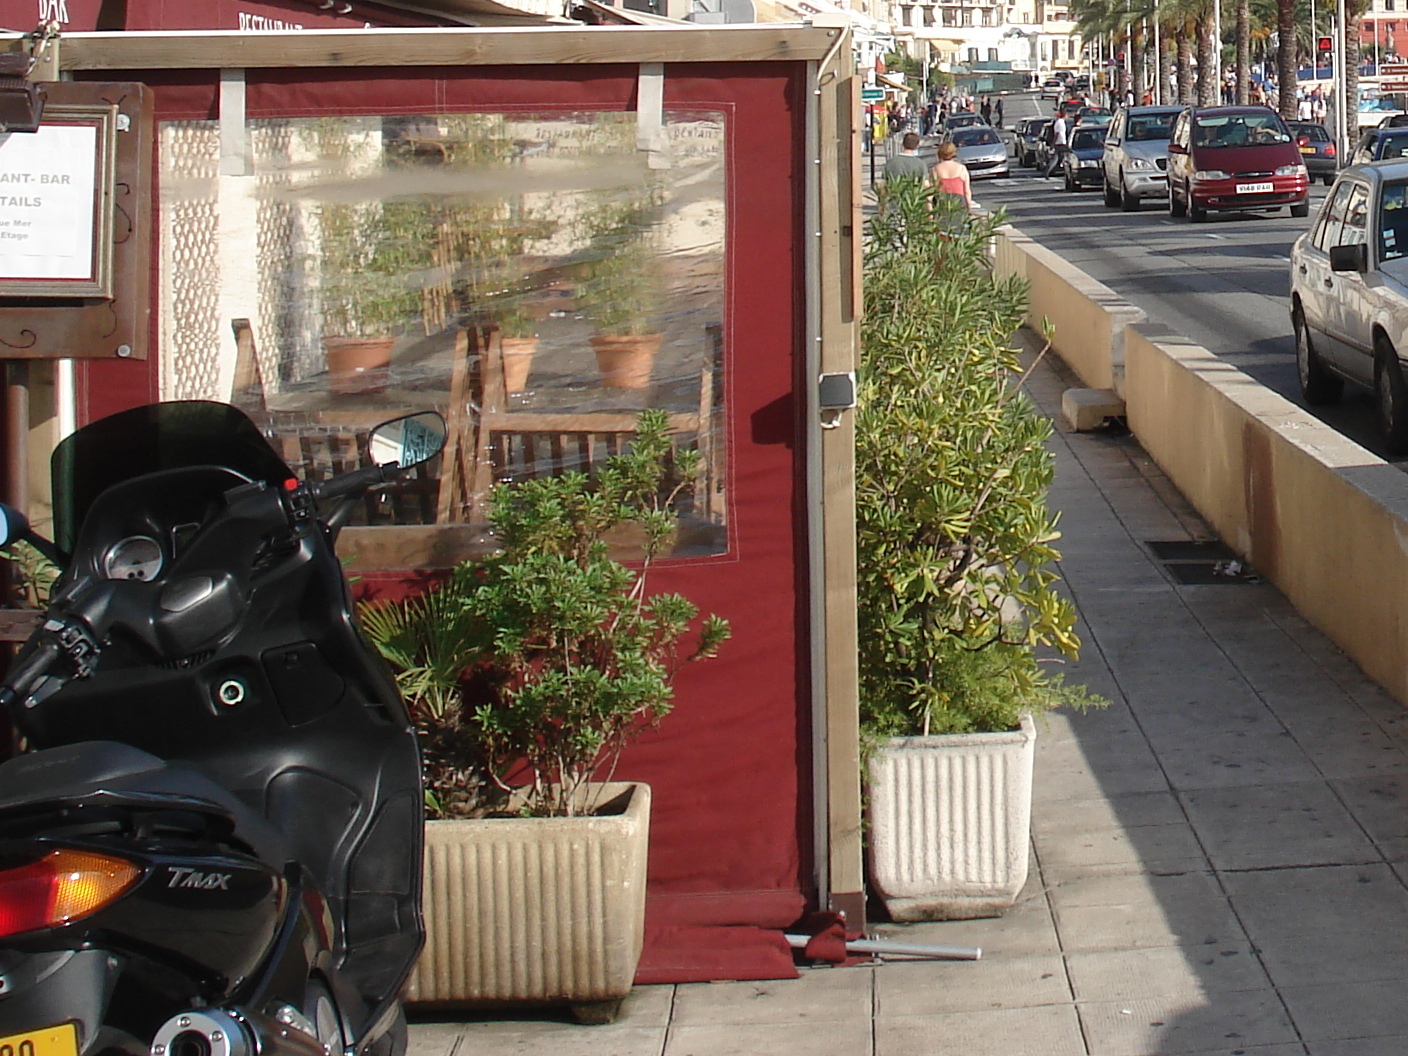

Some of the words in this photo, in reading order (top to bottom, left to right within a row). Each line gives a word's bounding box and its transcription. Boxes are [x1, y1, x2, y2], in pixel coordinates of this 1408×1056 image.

[238, 12, 304, 30] RESTAU
[40, 174, 70, 184] BAR
[0, 196, 42, 207] TAILS
